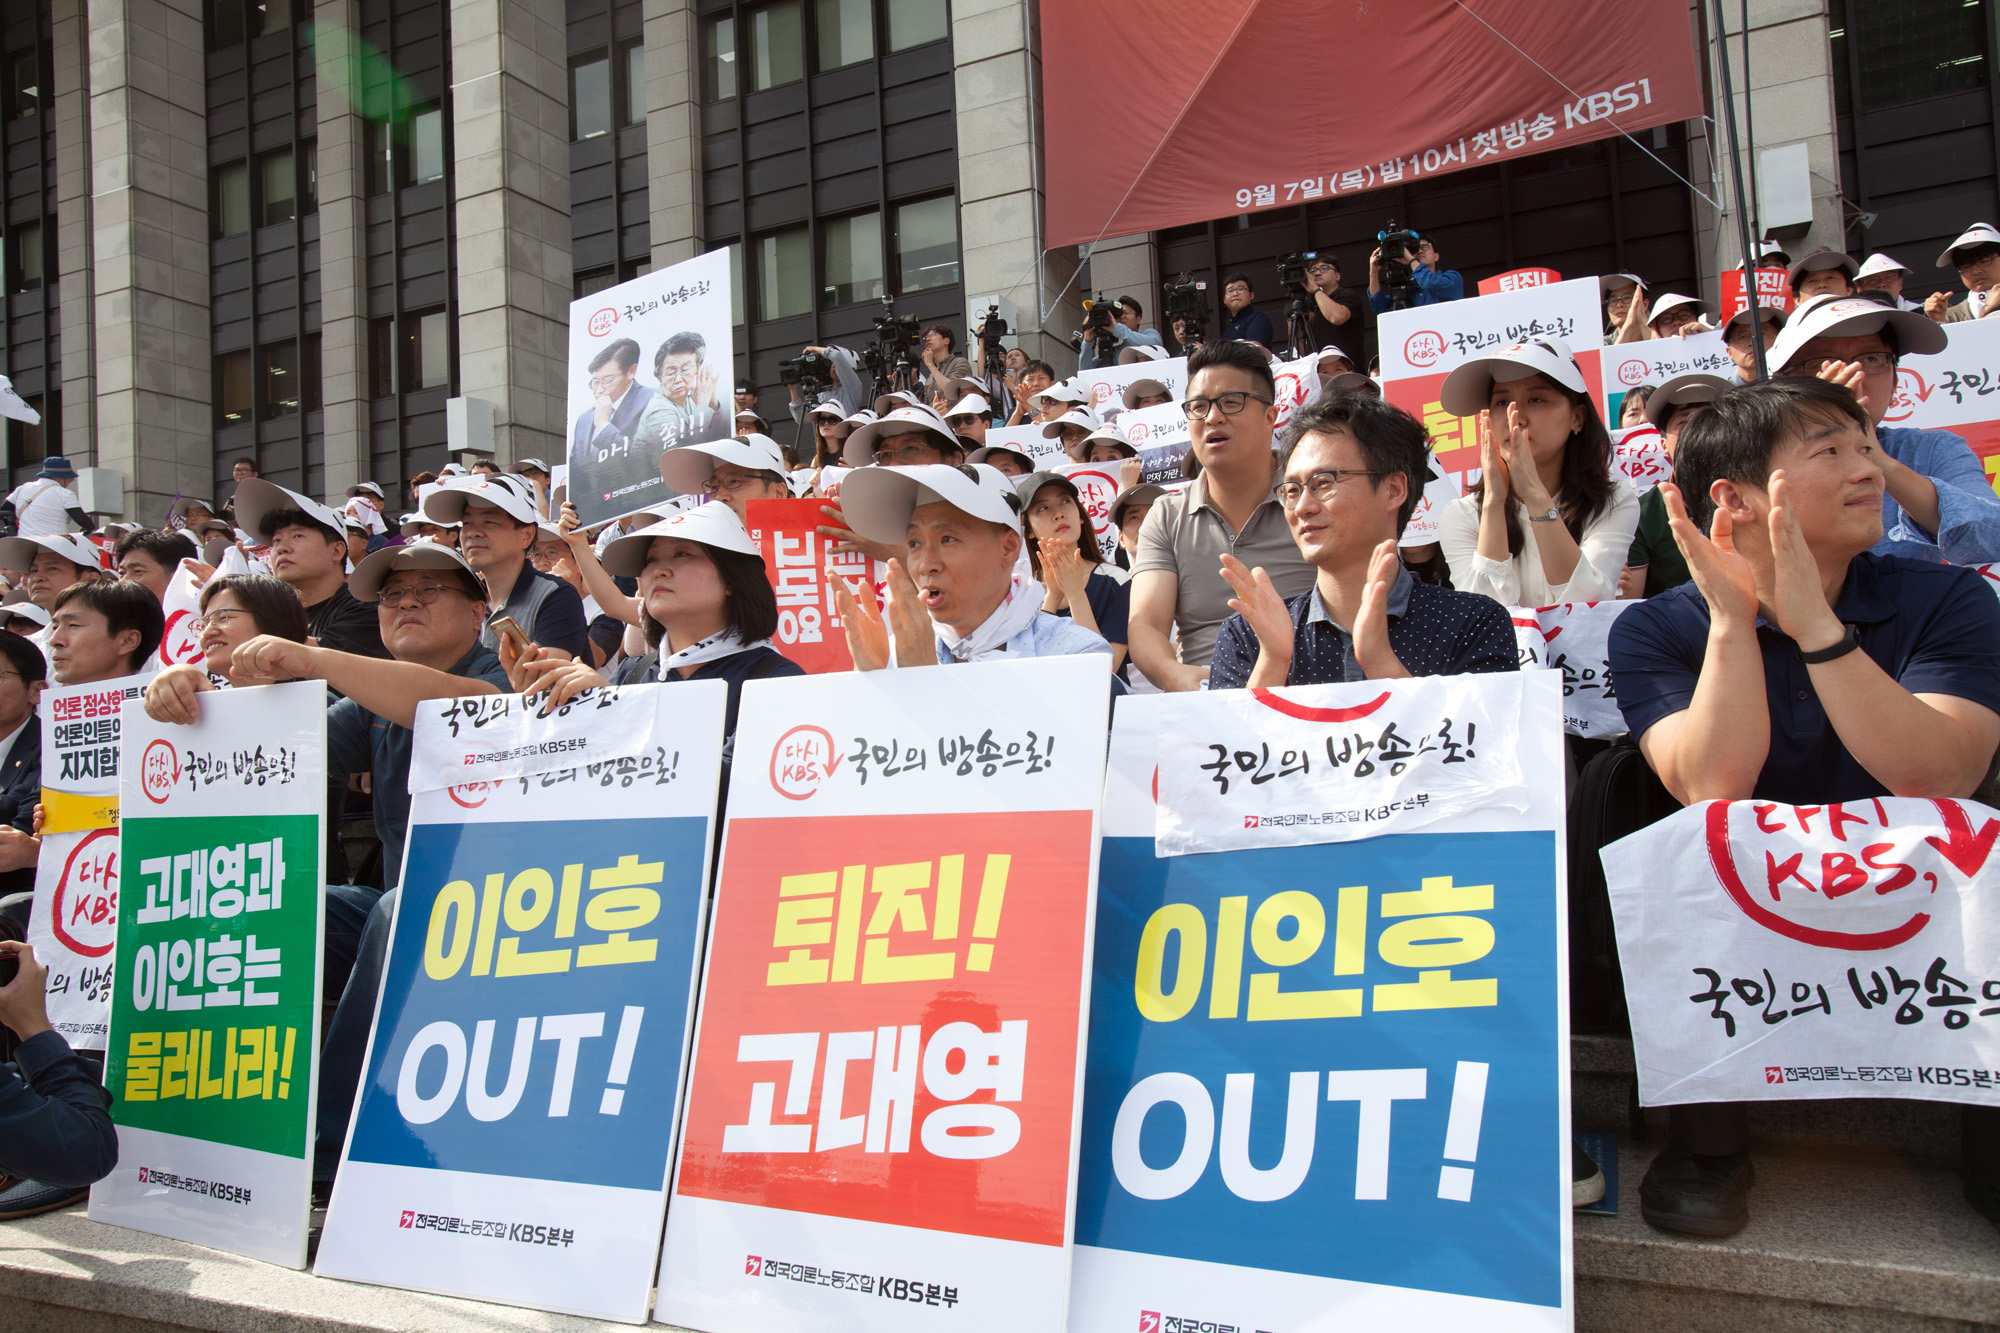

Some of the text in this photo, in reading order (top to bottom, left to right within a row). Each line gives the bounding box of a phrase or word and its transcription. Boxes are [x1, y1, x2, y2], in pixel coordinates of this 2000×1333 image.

[1236, 184, 1275, 208] 9월
[1284, 177, 1323, 200] 7일
[1330, 166, 1375, 193] (목)
[1563, 78, 1652, 129] KBS1
[624, 280, 710, 321] 국민의 방송으로!
[1412, 337, 1434, 348] 다시
[1453, 331, 1500, 355] 국민의
[1654, 361, 1690, 378] 국민의
[1939, 368, 2000, 404] 국민
[1027, 444, 1053, 459] 국민의
[1152, 424, 1175, 439] 국민의
[1616, 443, 1657, 459] 다시
[1081, 501, 1109, 519] BS
[773, 531, 823, 645] 고대영
[53, 696, 82, 722] 언론
[441, 695, 509, 738] 국민의
[149, 752, 169, 771] 다시
[185, 744, 295, 792] 국민의 방송으로!
[476, 737, 587, 764] 전국언론노동조합 KBS본부
[785, 739, 819, 760] 다시
[847, 727, 1055, 786] 국민의 방송으로!
[1200, 717, 1476, 795] 국민의 방송으로!
[1260, 810, 1360, 827] 전국언론노동조합
[1753, 797, 1889, 842] 다시
[137, 838, 286, 925] 고대영과
[1765, 843, 1938, 901] KBS,
[423, 854, 665, 981] 이인호
[766, 853, 1012, 986] 퇴진!
[1134, 875, 1498, 1023] 이인호
[133, 934, 282, 1012] 이인호는
[1689, 967, 1831, 1037] 국민의
[124, 1026, 297, 1101] 물러나라!
[396, 1005, 645, 1125] OUT!
[1784, 1066, 2000, 1089] 전국언론노동조합 KBS본
[722, 1019, 1028, 1160] 고대영
[1111, 1060, 1490, 1203] OUT!
[149, 1169, 252, 1206] 전국언론노동조합 KBS본부
[415, 1213, 574, 1248] 전국언론노동조합 KBS본부
[764, 1259, 959, 1308] 전국언론노동조합 KBS본부
